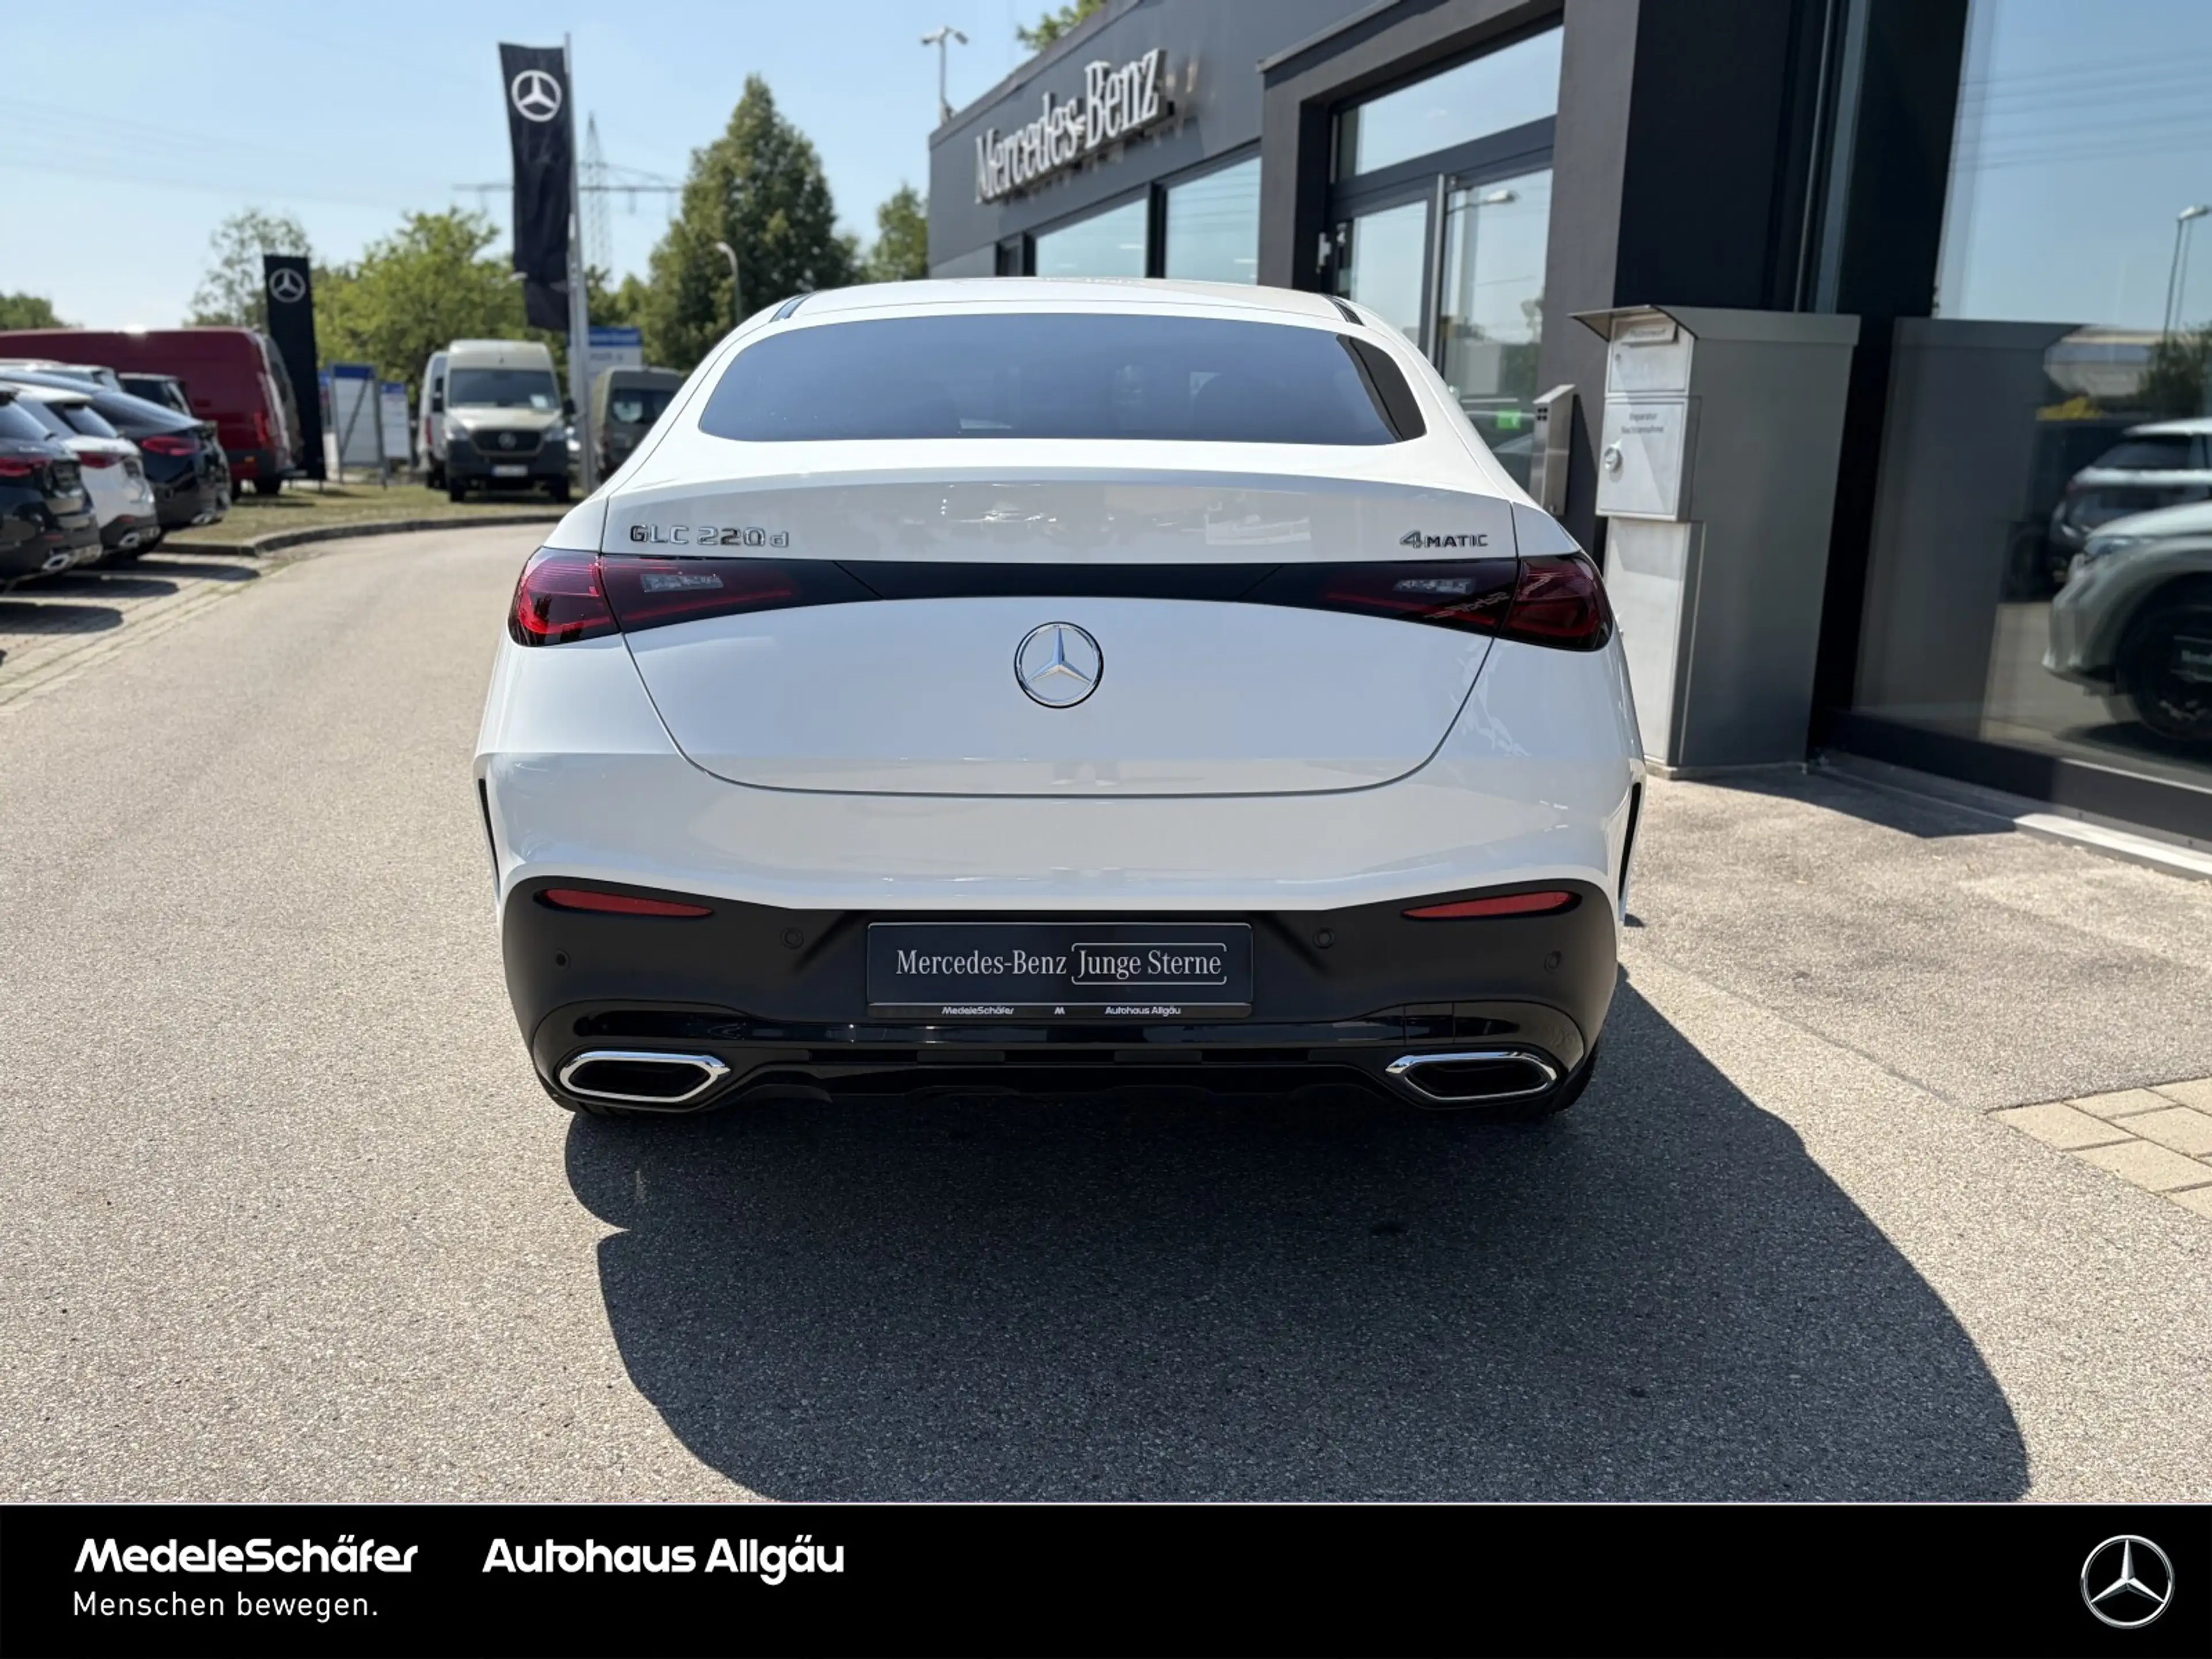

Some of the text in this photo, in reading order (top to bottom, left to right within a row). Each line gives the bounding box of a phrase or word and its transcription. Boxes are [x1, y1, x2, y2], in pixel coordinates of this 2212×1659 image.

[975, 48, 1159, 204] Mercedes-Benz
[630, 524, 690, 544] GLC
[1399, 529, 1488, 548] 4MATIC
[896, 949, 1221, 980] Mercedes-Benz Junge Sterne
[941, 1005, 1014, 1015] MedeleSchäfer
[1104, 1006, 1181, 1017] Autohaus Allgäu
